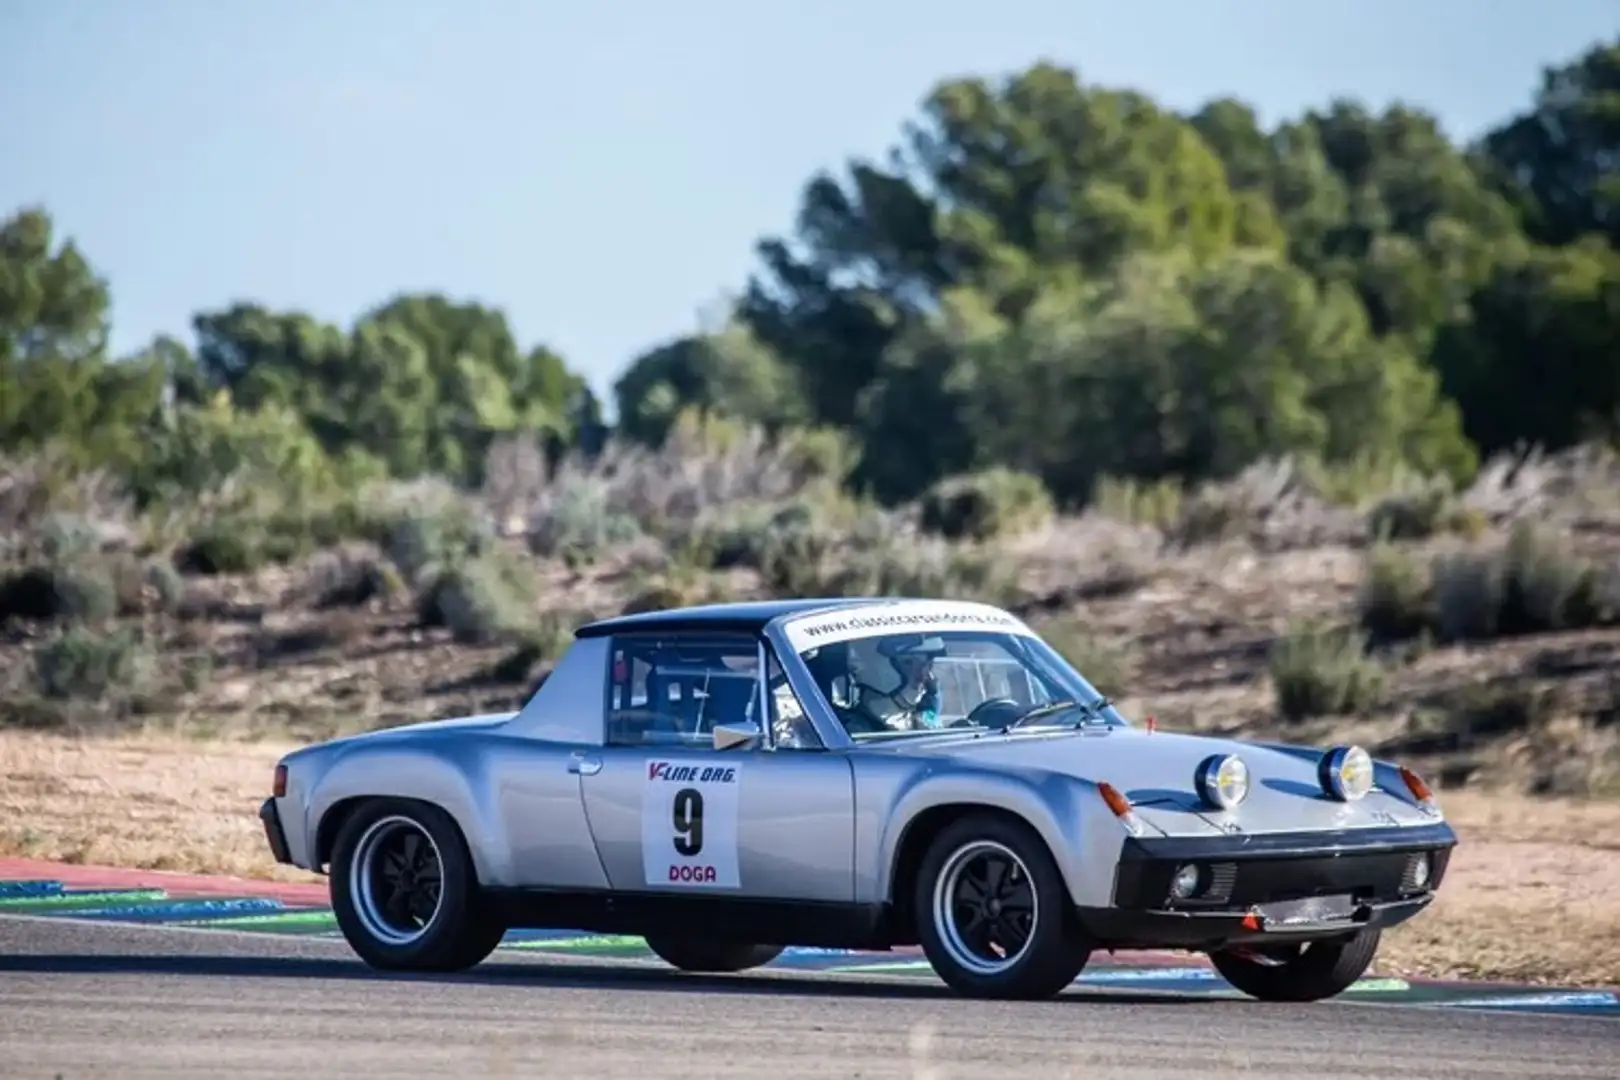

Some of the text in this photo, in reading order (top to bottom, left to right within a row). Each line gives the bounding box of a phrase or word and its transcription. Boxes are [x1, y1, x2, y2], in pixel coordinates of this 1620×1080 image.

[648, 762, 700, 782] V-LINE
[673, 788, 704, 857] 9
[668, 865, 717, 883] DOGA
